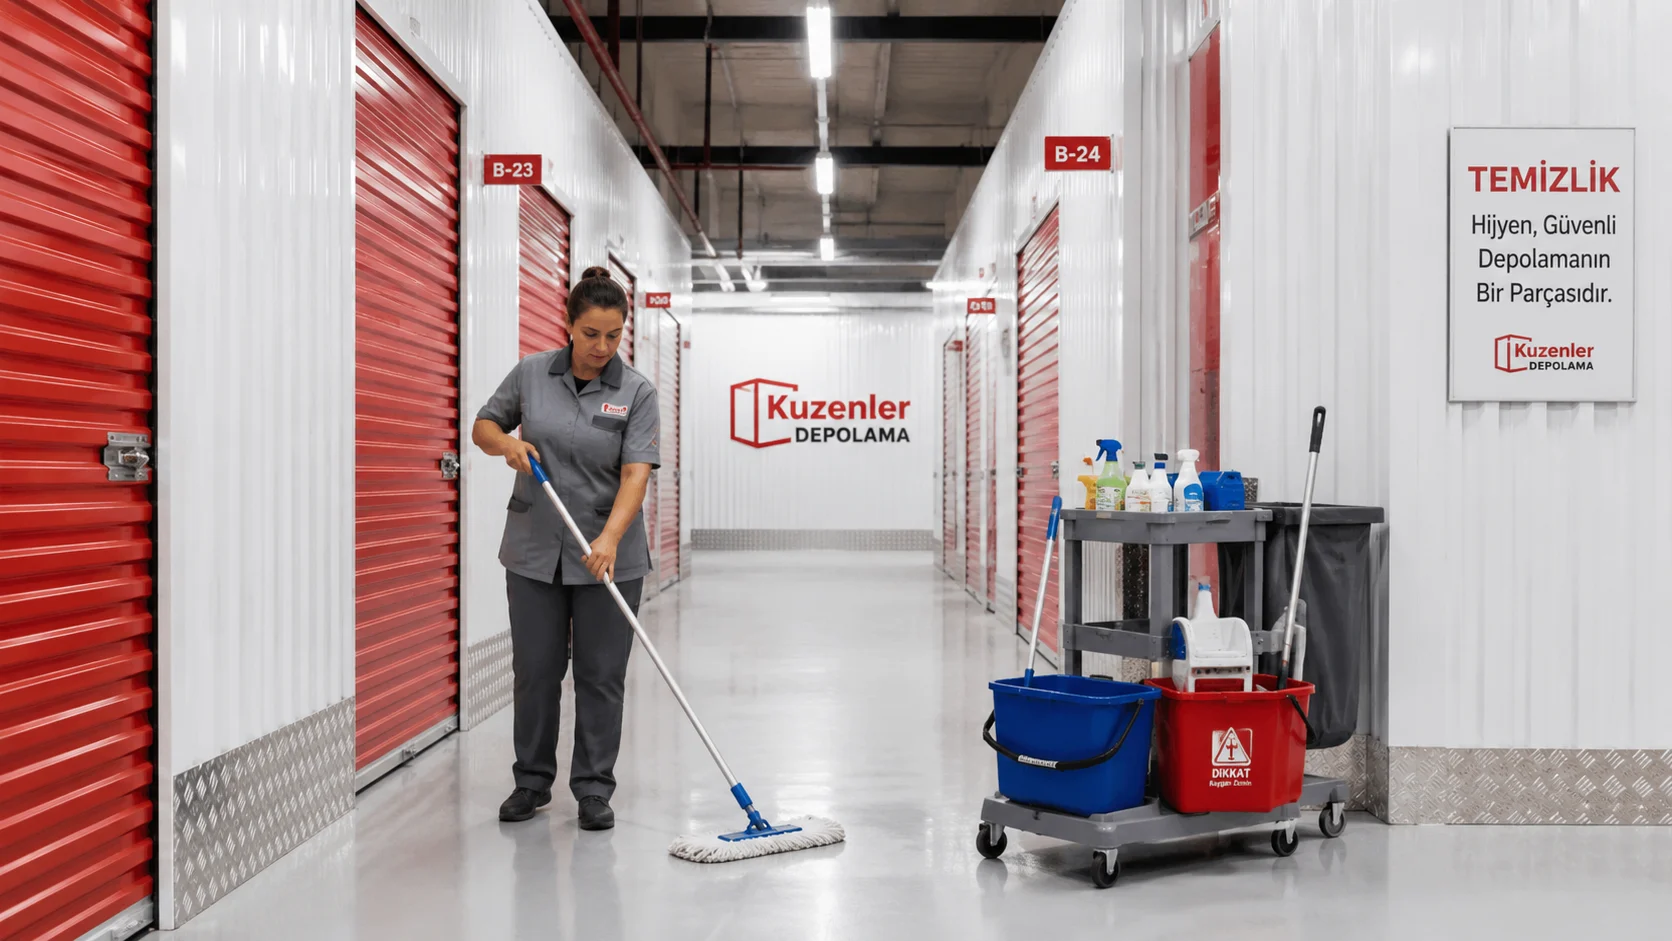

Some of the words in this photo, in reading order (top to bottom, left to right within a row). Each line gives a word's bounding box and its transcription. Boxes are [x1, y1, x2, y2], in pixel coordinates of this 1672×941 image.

[1055, 145, 1101, 163] B-24
[492, 162, 534, 178] B-23
[1467, 159, 1620, 193] TEMİZLİK
[1472, 214, 1537, 239] Hijyen,
[1543, 214, 1616, 235] Güvenli
[1479, 248, 1610, 273] Depolamanın
[1477, 282, 1504, 303] Bir
[1510, 282, 1612, 308] Parçasıdır.
[1514, 342, 1595, 358] Kuzenler
[1529, 361, 1594, 371] DEPOLAMA
[767, 393, 911, 421] Kuzenler
[795, 427, 910, 443] DEPOLAMA
